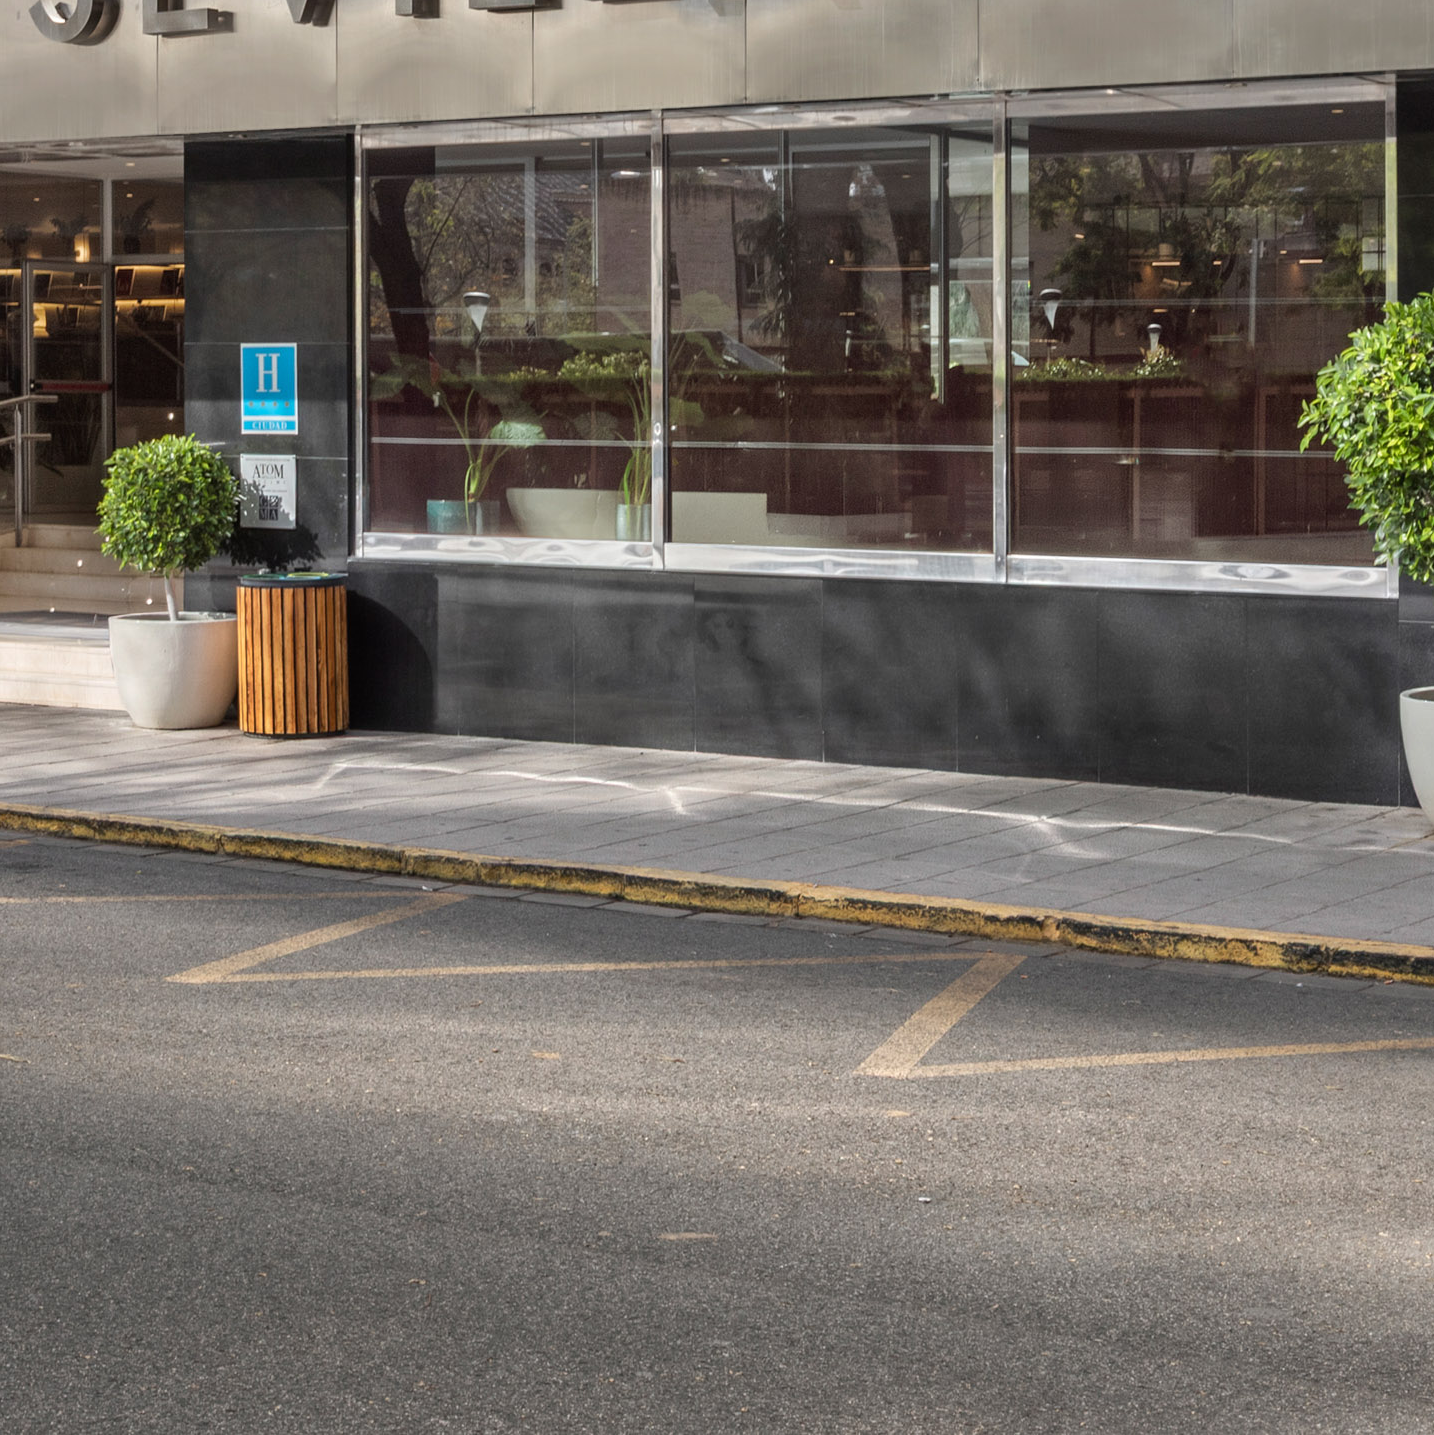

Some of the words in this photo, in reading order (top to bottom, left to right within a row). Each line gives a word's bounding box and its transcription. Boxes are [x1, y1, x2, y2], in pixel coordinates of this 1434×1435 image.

[255, 352, 282, 393] H
[252, 421, 288, 430] CIUDAD
[253, 463, 285, 479] ATOM
